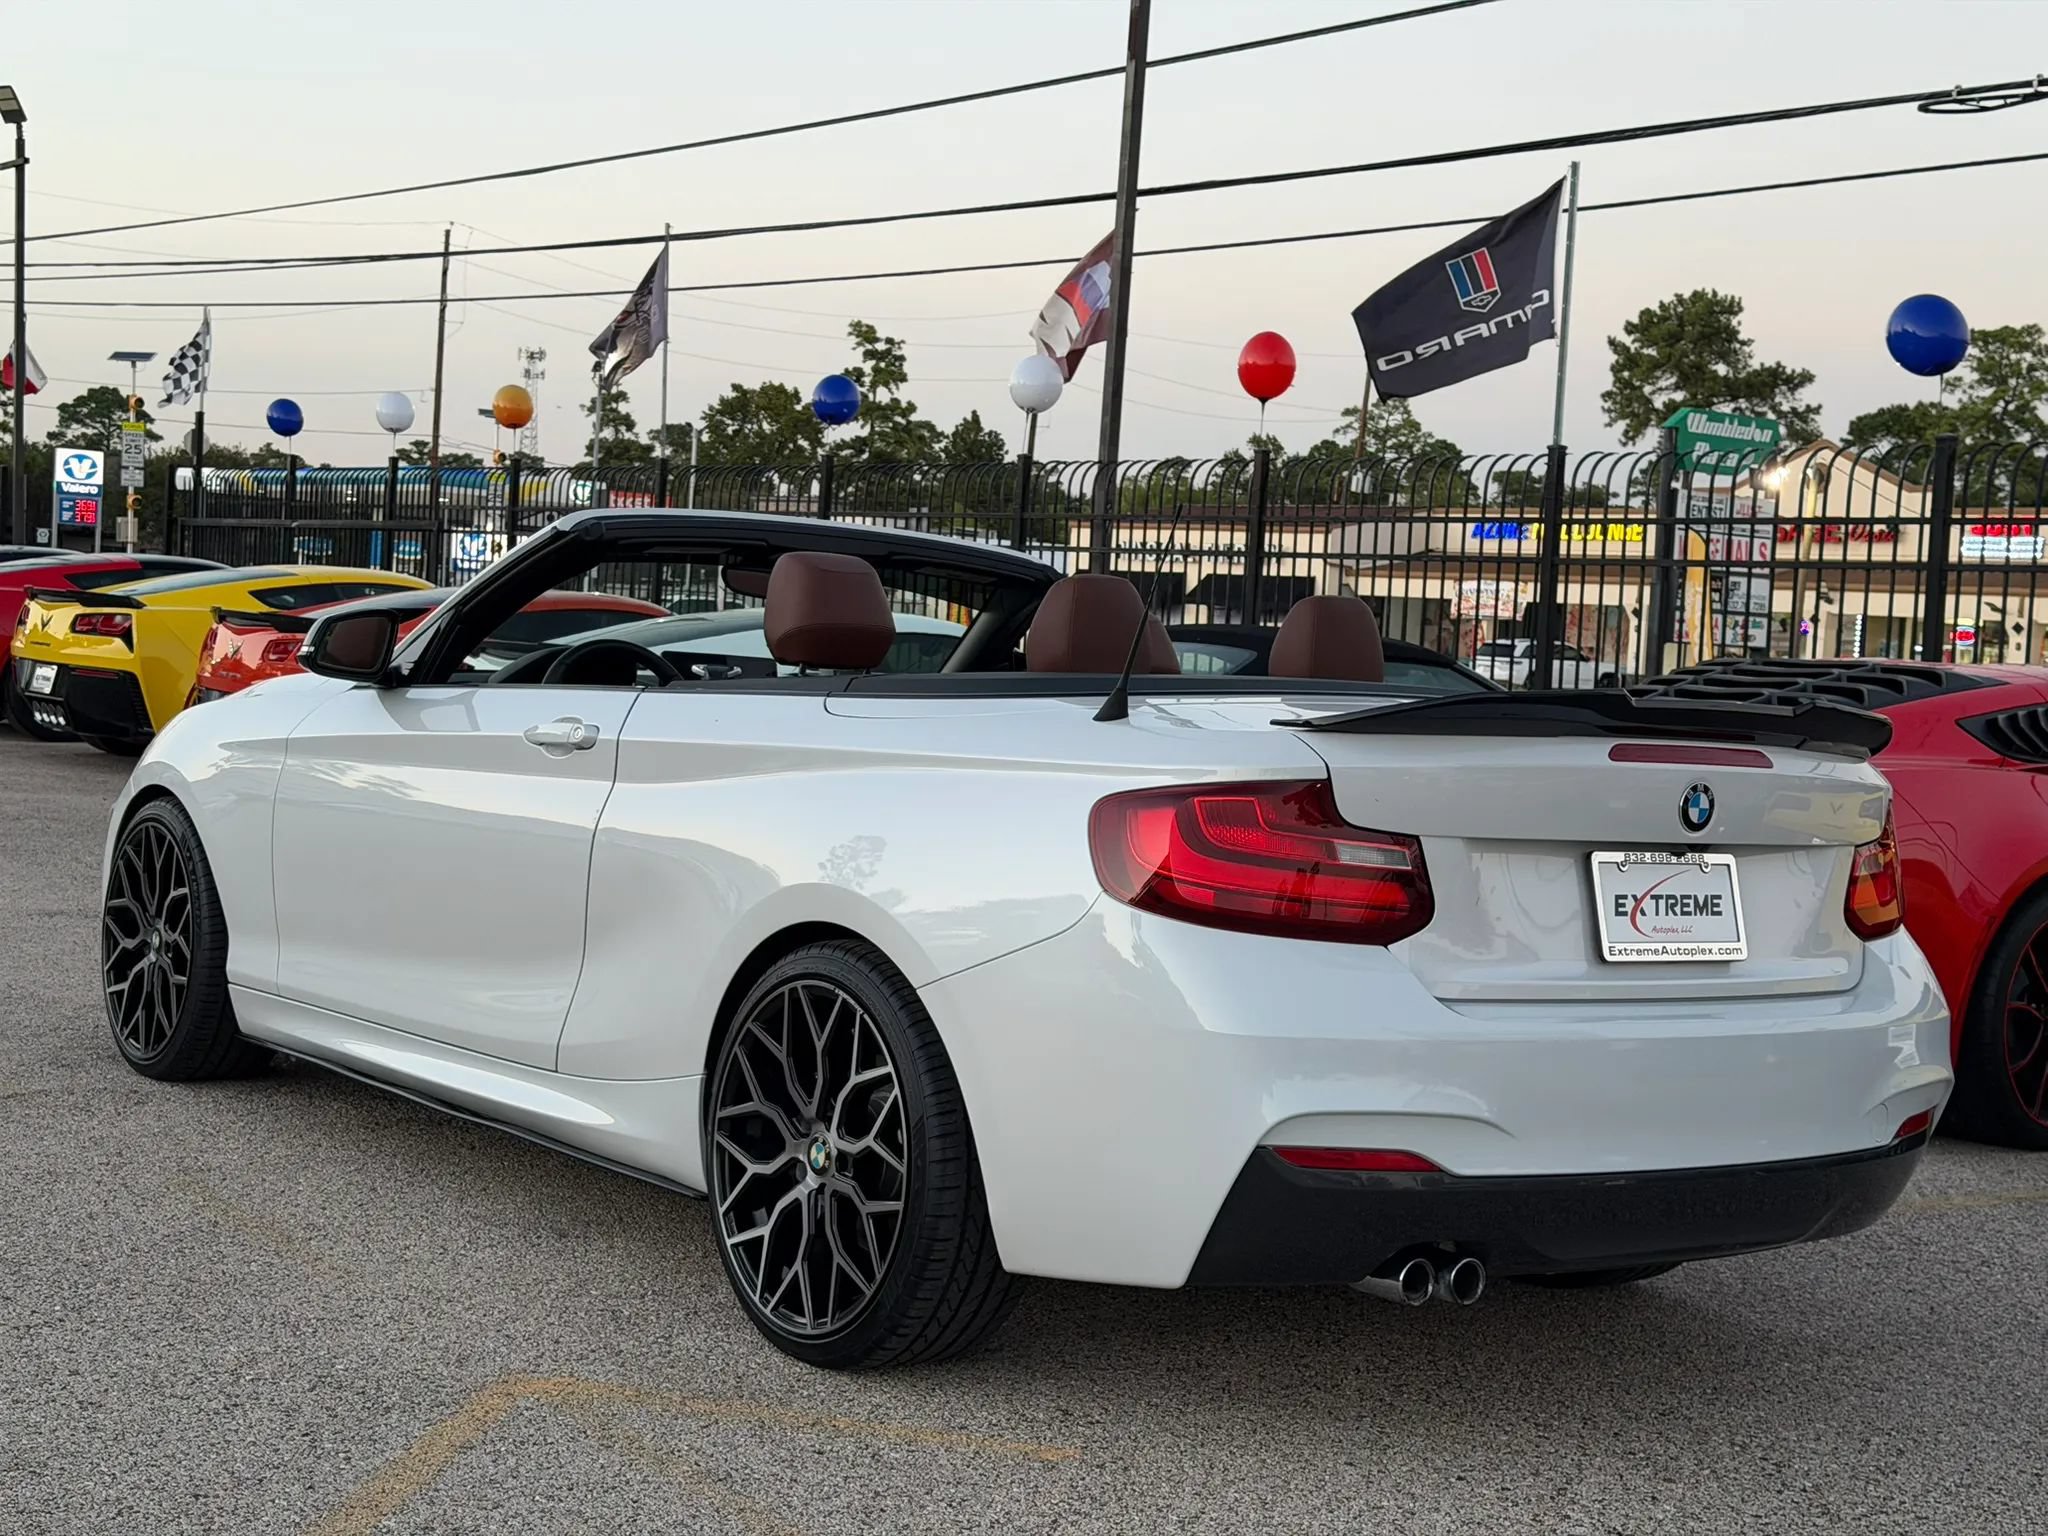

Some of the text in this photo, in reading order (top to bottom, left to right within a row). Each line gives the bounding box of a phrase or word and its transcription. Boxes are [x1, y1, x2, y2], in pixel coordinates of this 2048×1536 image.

[1687, 412, 1773, 442] Wimbledon
[124, 443, 143, 455] 25
[61, 482, 98, 495] Valero
[1614, 894, 1723, 917] EXTREME
[1680, 925, 1693, 934] LLC
[1608, 945, 1743, 958] ExtremeAutoplex.com
